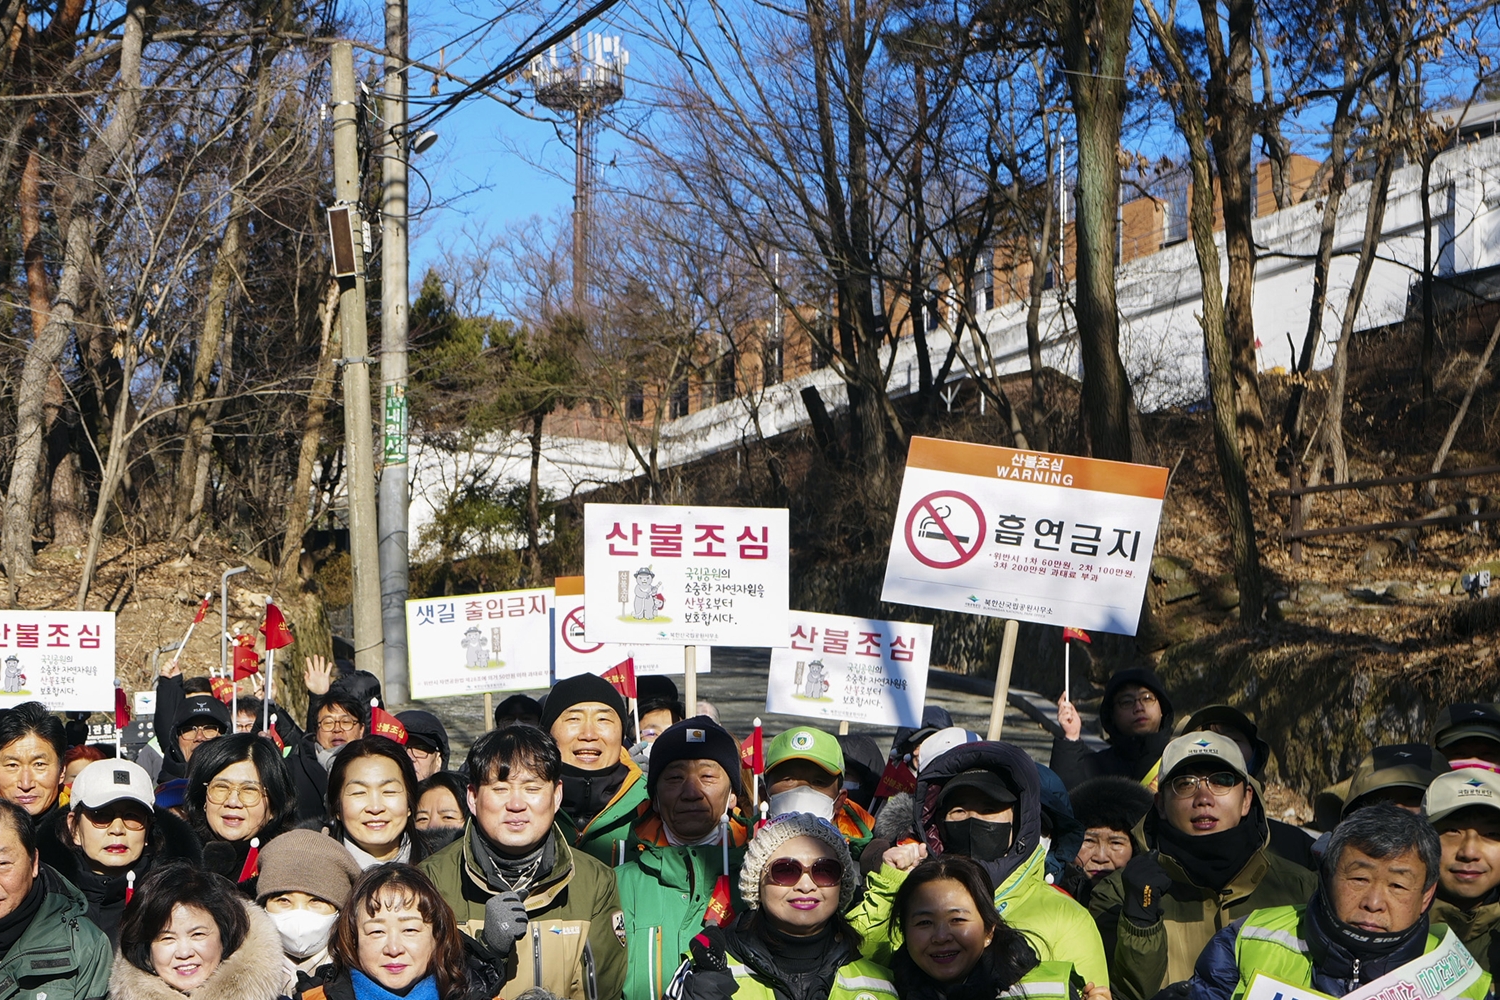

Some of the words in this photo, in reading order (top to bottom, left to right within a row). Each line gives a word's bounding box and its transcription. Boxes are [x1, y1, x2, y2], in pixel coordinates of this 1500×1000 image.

[1011, 453, 1064, 471] 산불조심
[996, 465, 1074, 486] WARNING
[606, 522, 768, 559] 산불조심
[994, 514, 1141, 562] 흡연금지
[994, 552, 1020, 562] 위반시
[685, 567, 730, 581] 국립공원의
[685, 583, 712, 596] 소중한
[715, 583, 764, 598] 자연자원을
[416, 603, 455, 626] 샛길
[465, 594, 547, 621] 출입금지
[685, 598, 733, 611] 산불로부터
[685, 612, 737, 626] 보호합시다.
[790, 625, 915, 662] 산불조심
